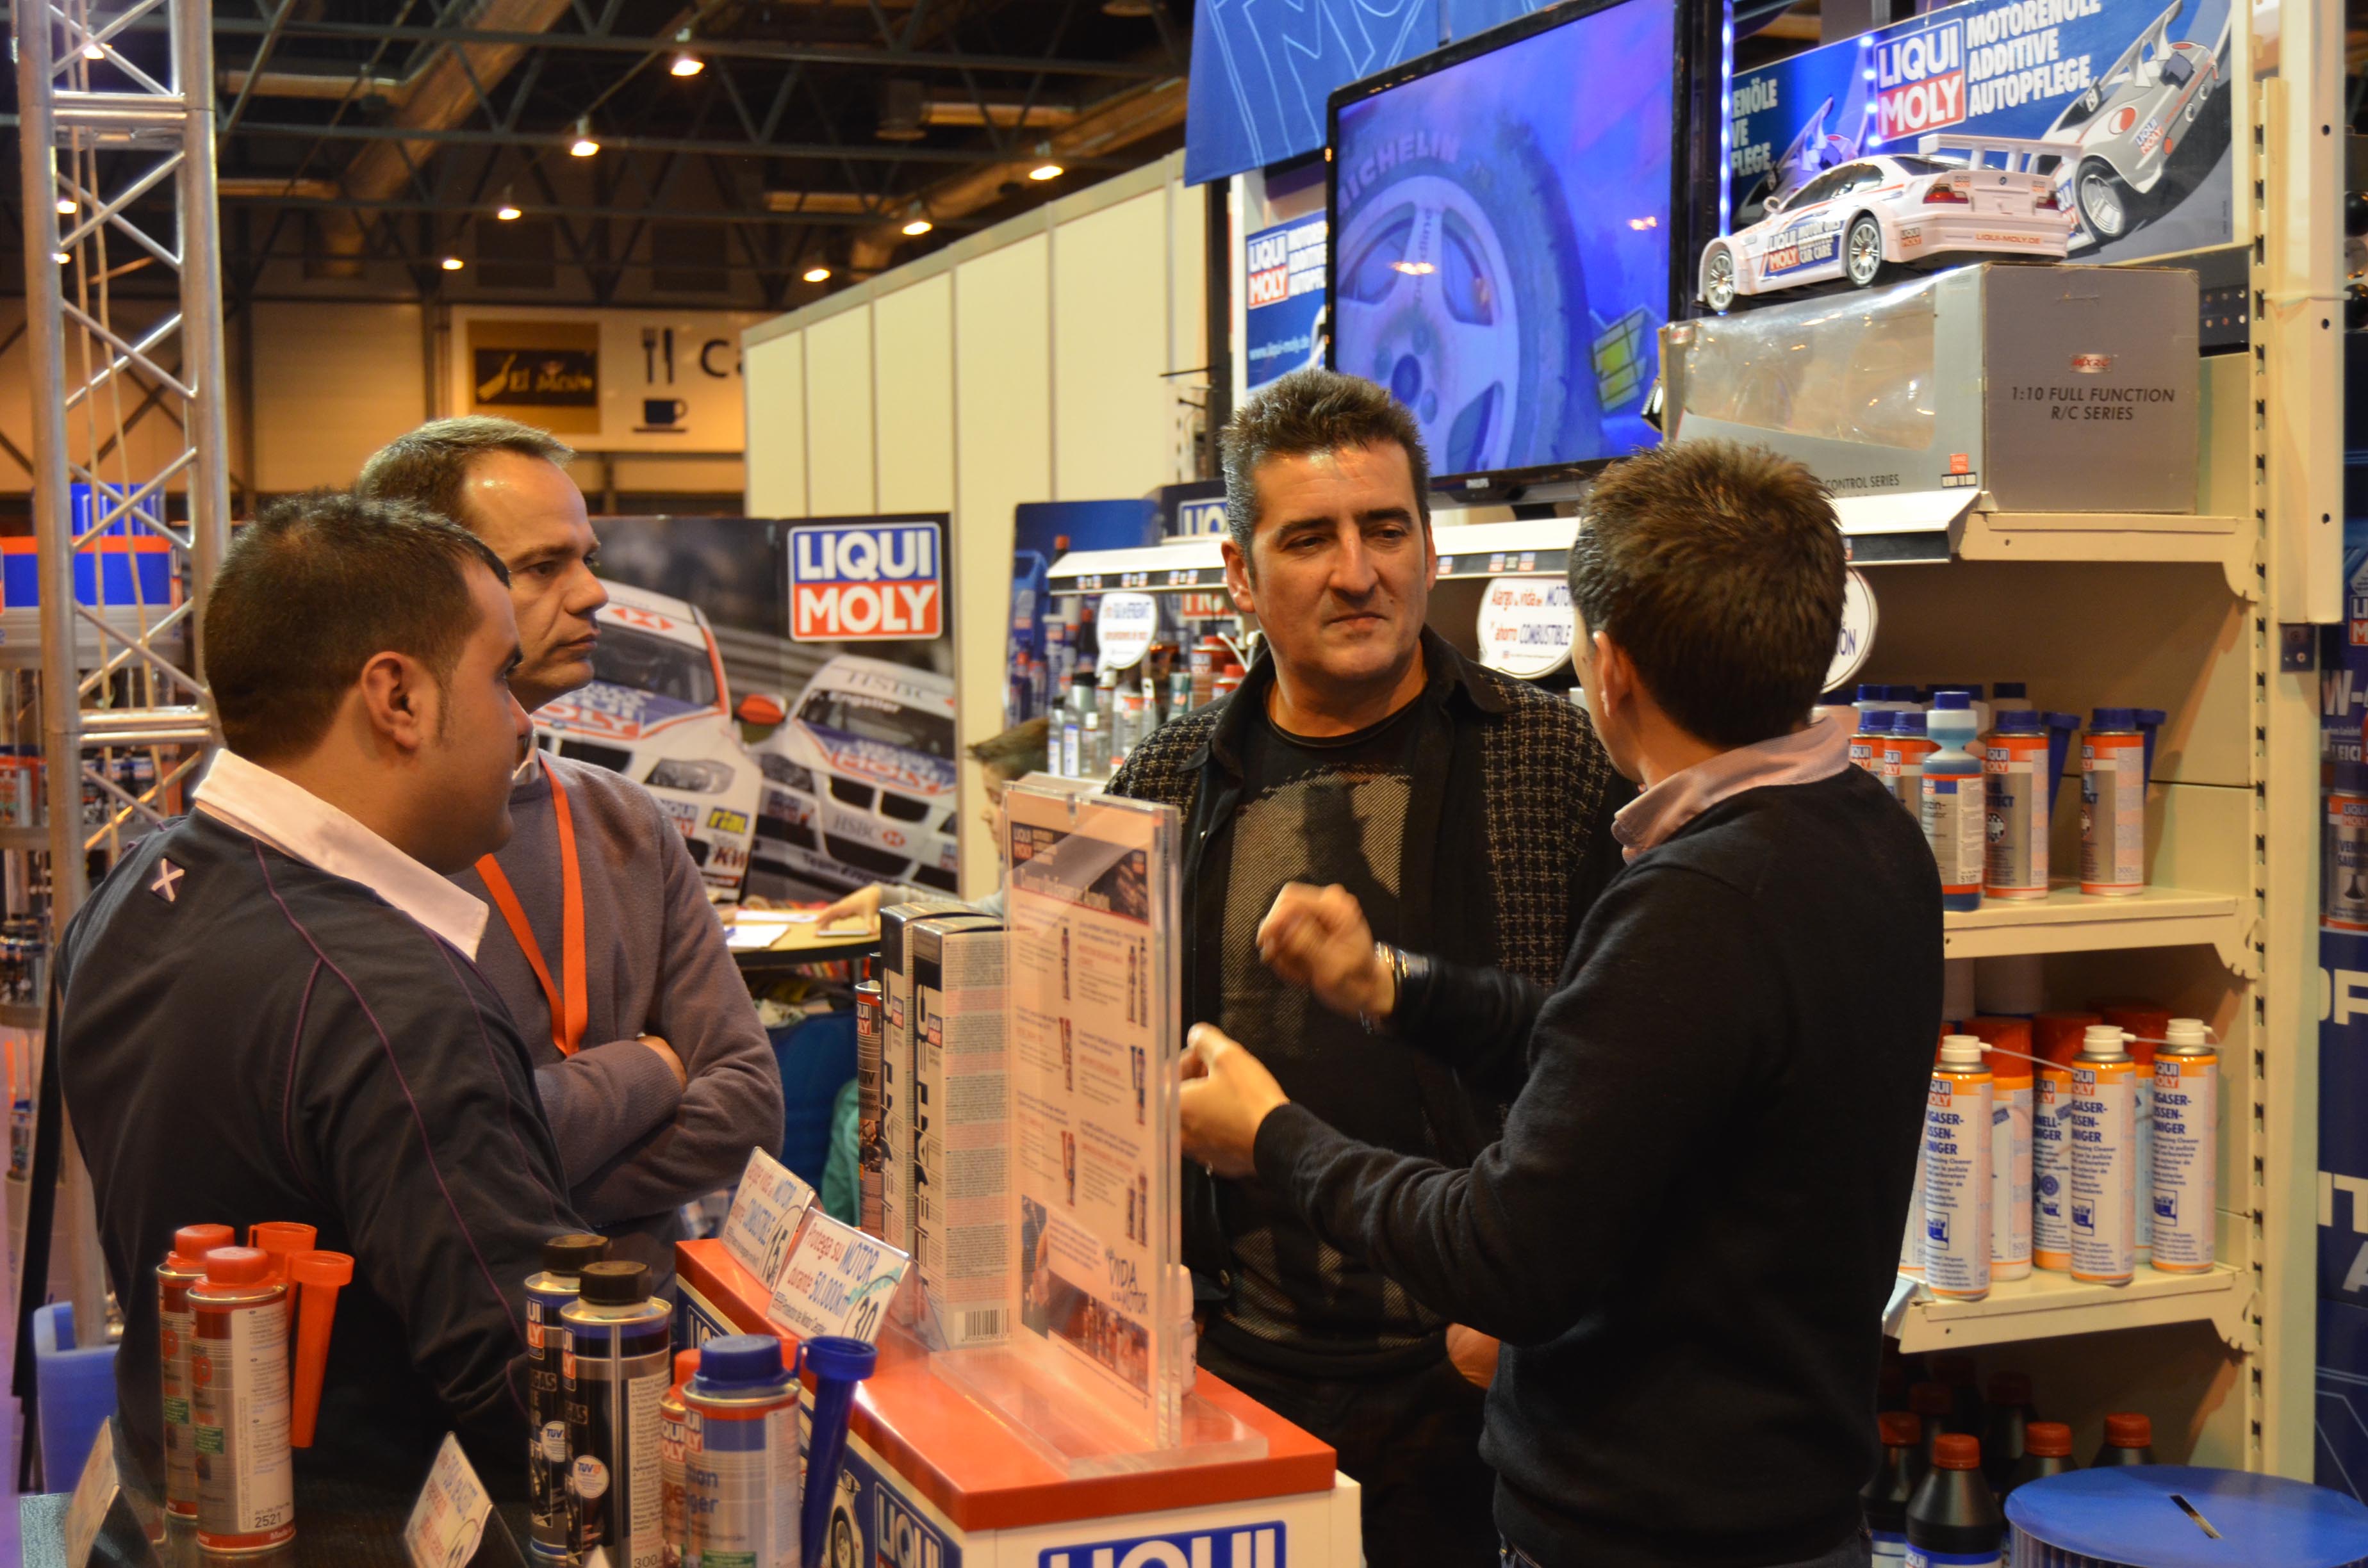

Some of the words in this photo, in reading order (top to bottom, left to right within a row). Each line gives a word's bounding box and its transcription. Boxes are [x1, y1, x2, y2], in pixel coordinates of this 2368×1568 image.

[1878, 27, 1959, 89] LIQUI
[1968, 28, 2059, 83] ADDITIVE
[1881, 75, 1962, 137] MOLY
[1770, 228, 1798, 253] LIQUI
[1976, 234, 2041, 245] LIQUI-MOLY.DE
[1249, 236, 1286, 273] LIQUI
[1770, 247, 1799, 272] MOLY
[1800, 249, 1813, 264] CAR
[1814, 244, 1833, 260] CARE
[1249, 268, 1287, 304] MOLY
[2012, 387, 2044, 400] 1:10
[2049, 387, 2084, 402] FULL
[2089, 388, 2176, 403] FUNCTION
[2051, 405, 2079, 421] R/C
[2083, 406, 2134, 421] SERIES
[1825, 476, 1868, 491] CONTROL
[1870, 474, 1900, 489] SERIES
[798, 529, 932, 582] LIQUI
[799, 585, 937, 634] MOLY
[1520, 623, 1572, 646] COMBUSTIBLE
[847, 671, 923, 699] HSBC
[837, 1237, 881, 1283] MOTOR
[254, 1512, 282, 1529] 2521
